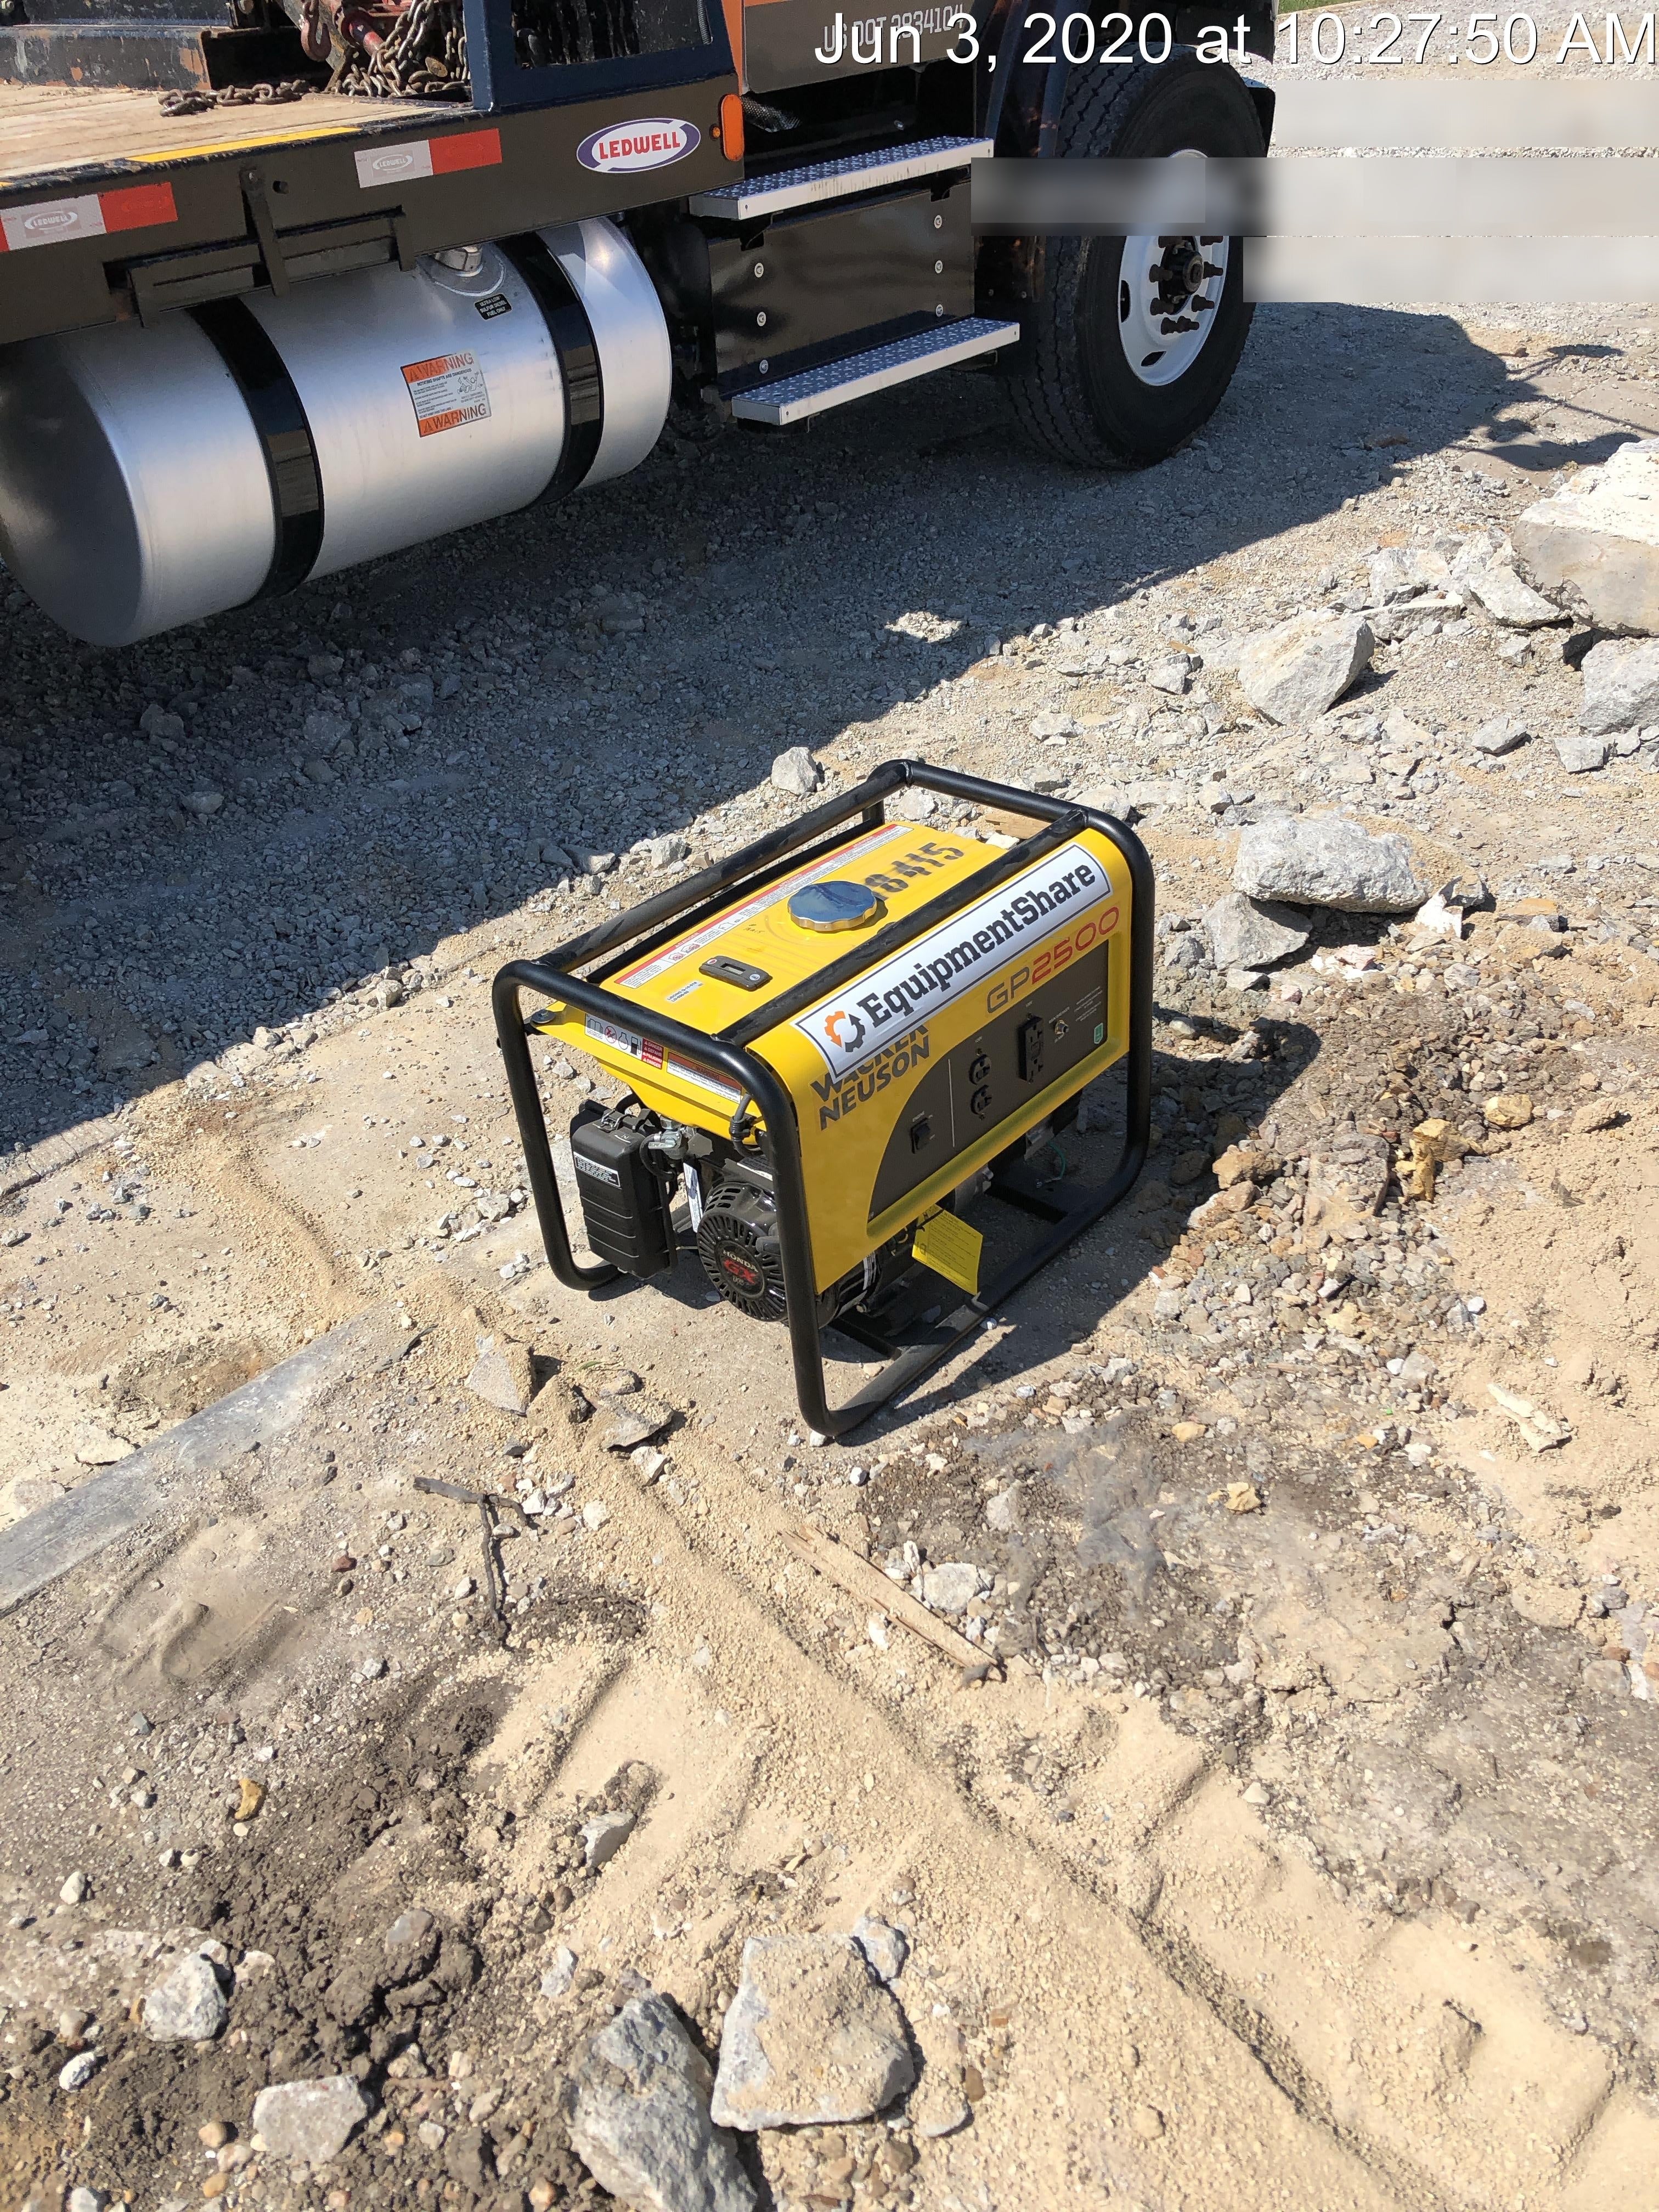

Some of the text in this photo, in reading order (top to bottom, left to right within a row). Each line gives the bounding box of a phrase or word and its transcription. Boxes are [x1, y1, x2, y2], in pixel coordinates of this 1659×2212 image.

[599, 132, 681, 160] LEDWELL
[379, 157, 407, 168] LEDWELL
[416, 352, 474, 377] WARNING
[432, 403, 487, 428] WARNING
[865, 842, 964, 901] 8415
[856, 864, 1096, 1029] EquipmentShare
[986, 906, 1119, 1014] GP2500
[819, 1035, 930, 1131] NEUSON
[723, 1250, 758, 1272] HONDA
[724, 1259, 755, 1285] GX
